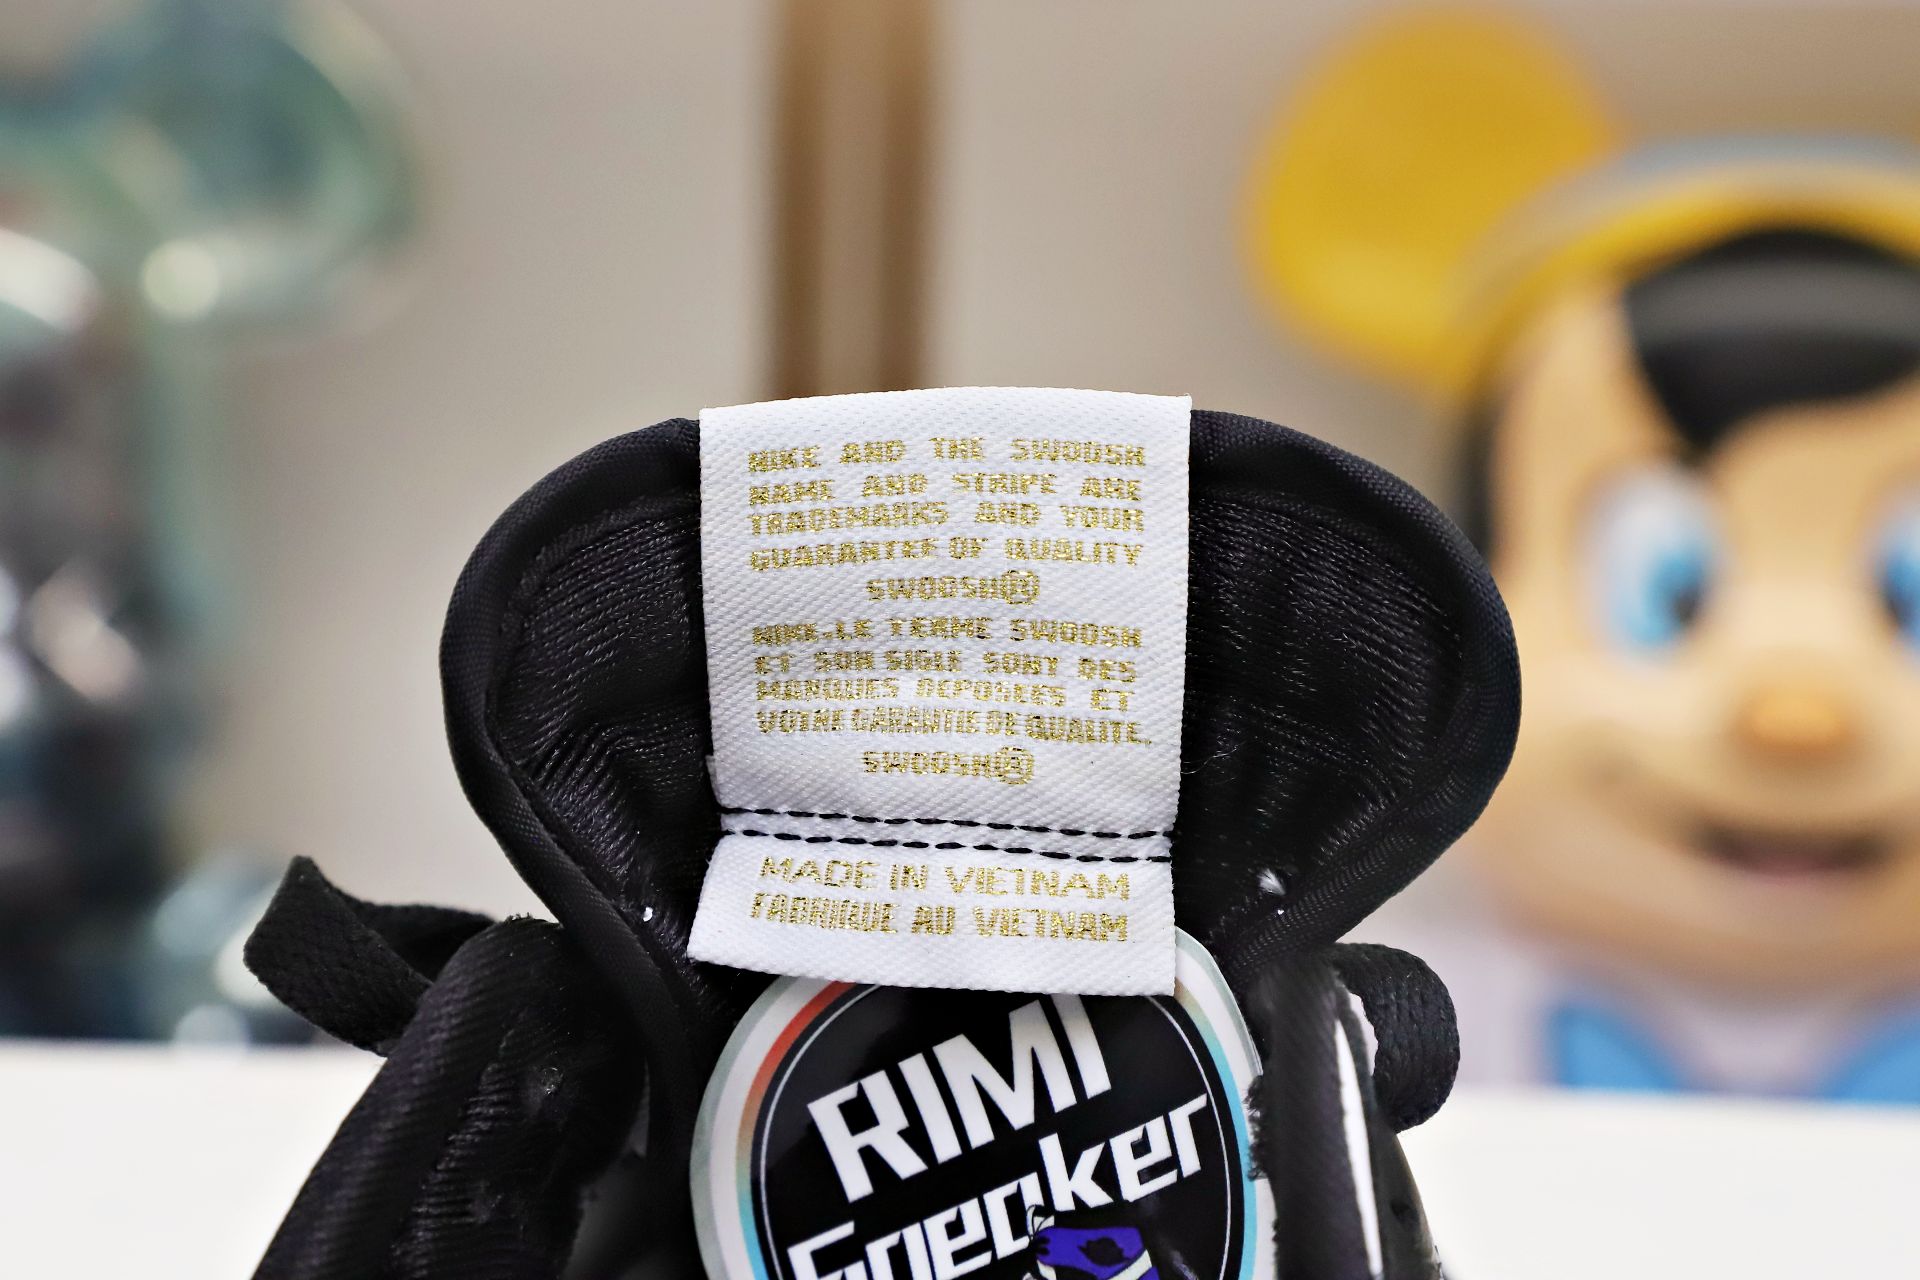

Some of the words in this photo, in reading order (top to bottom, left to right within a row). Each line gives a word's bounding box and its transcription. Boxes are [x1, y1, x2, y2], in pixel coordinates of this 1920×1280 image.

[749, 445, 821, 472] NIKE
[840, 439, 906, 464] AND
[929, 437, 986, 461] THE
[1009, 438, 1146, 467] SWOOSH
[749, 479, 835, 505] NAME
[861, 473, 928, 497] AND
[952, 472, 1057, 495] STRIPE
[1079, 477, 1143, 501] ARE
[748, 501, 949, 536] TRADEMARKS
[975, 501, 1041, 527] AND
[1059, 505, 1144, 532] YOUR
[750, 537, 939, 571] GUARANTEE
[949, 536, 988, 560] OF
[1005, 537, 1144, 566] QUALITY
[887, 616, 994, 639] TERME
[1009, 618, 1143, 648] SWOOSH
[755, 653, 794, 675] ET
[815, 650, 876, 674] SON
[885, 649, 962, 673] SIGLE
[982, 651, 1060, 678] SONT
[1078, 656, 1137, 683] DES
[756, 678, 900, 702] MARQUES
[916, 678, 1067, 708] DEPOSEES
[1090, 687, 1134, 712] ET
[756, 708, 844, 734] VOTRE
[851, 705, 980, 735] GARANTIE
[985, 710, 1020, 737] DE
[759, 855, 879, 890] MADE
[890, 864, 928, 891] IN
[945, 865, 1130, 901] VIETNAM
[750, 892, 897, 934] FABRIQUE
[911, 904, 956, 935] AU
[974, 905, 1129, 942] VIETNAM
[807, 994, 1112, 1203] RIMI
